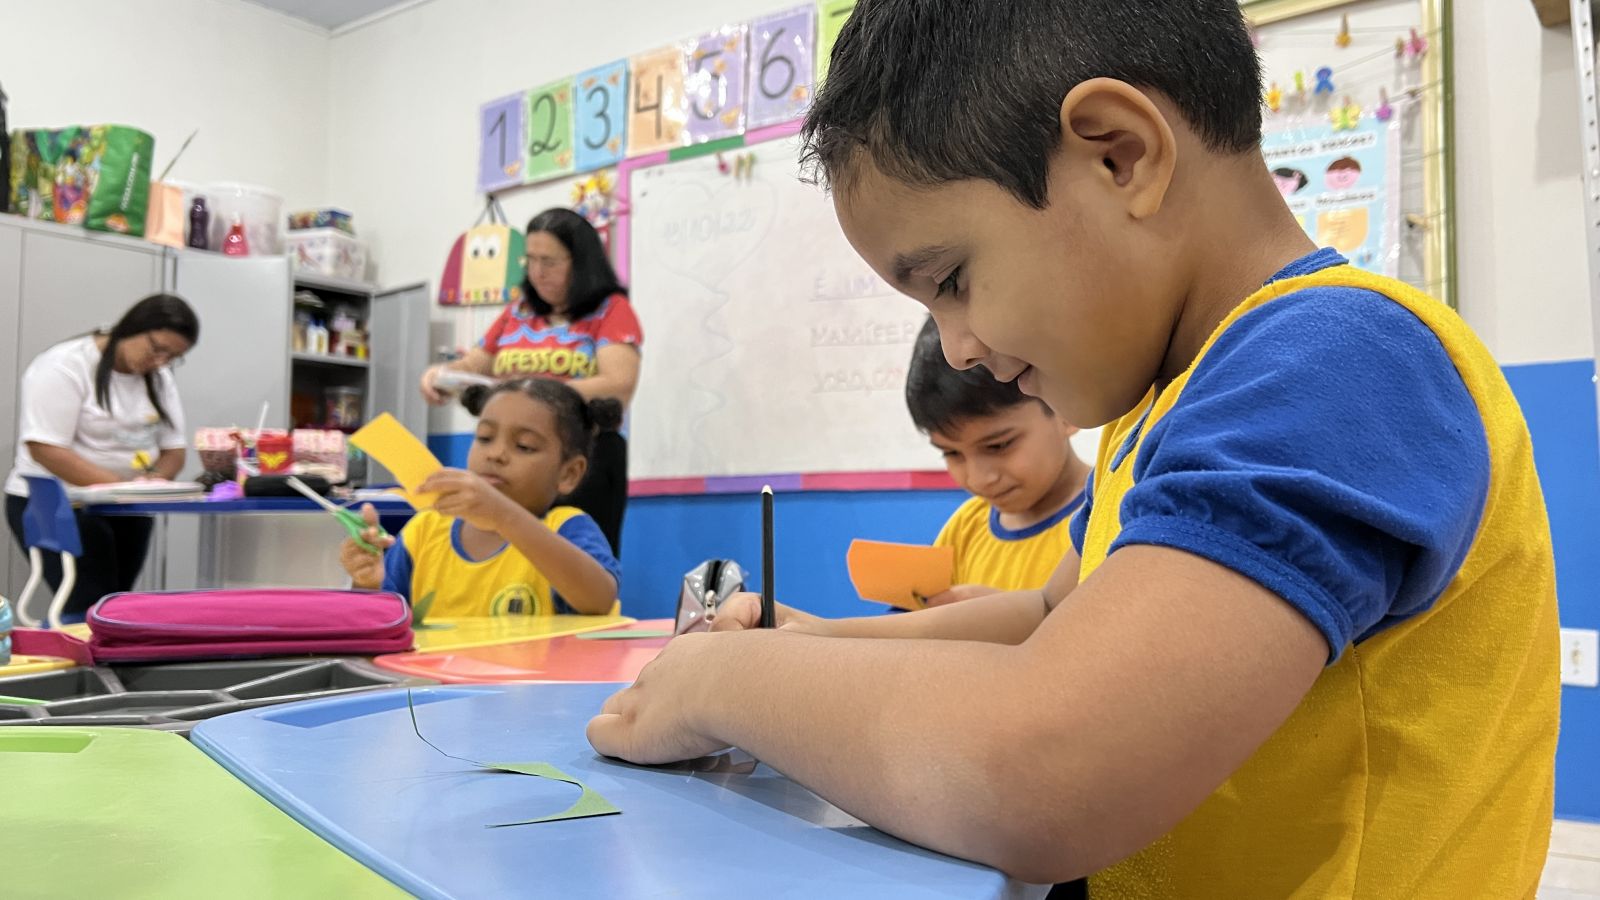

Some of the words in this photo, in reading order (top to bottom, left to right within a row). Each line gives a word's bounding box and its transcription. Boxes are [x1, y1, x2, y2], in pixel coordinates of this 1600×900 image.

[488, 110, 507, 168] 1
[529, 92, 562, 158] 2
[583, 85, 612, 151] 3
[634, 74, 664, 140] 4
[692, 50, 726, 121] 5
[758, 26, 797, 100] 6
